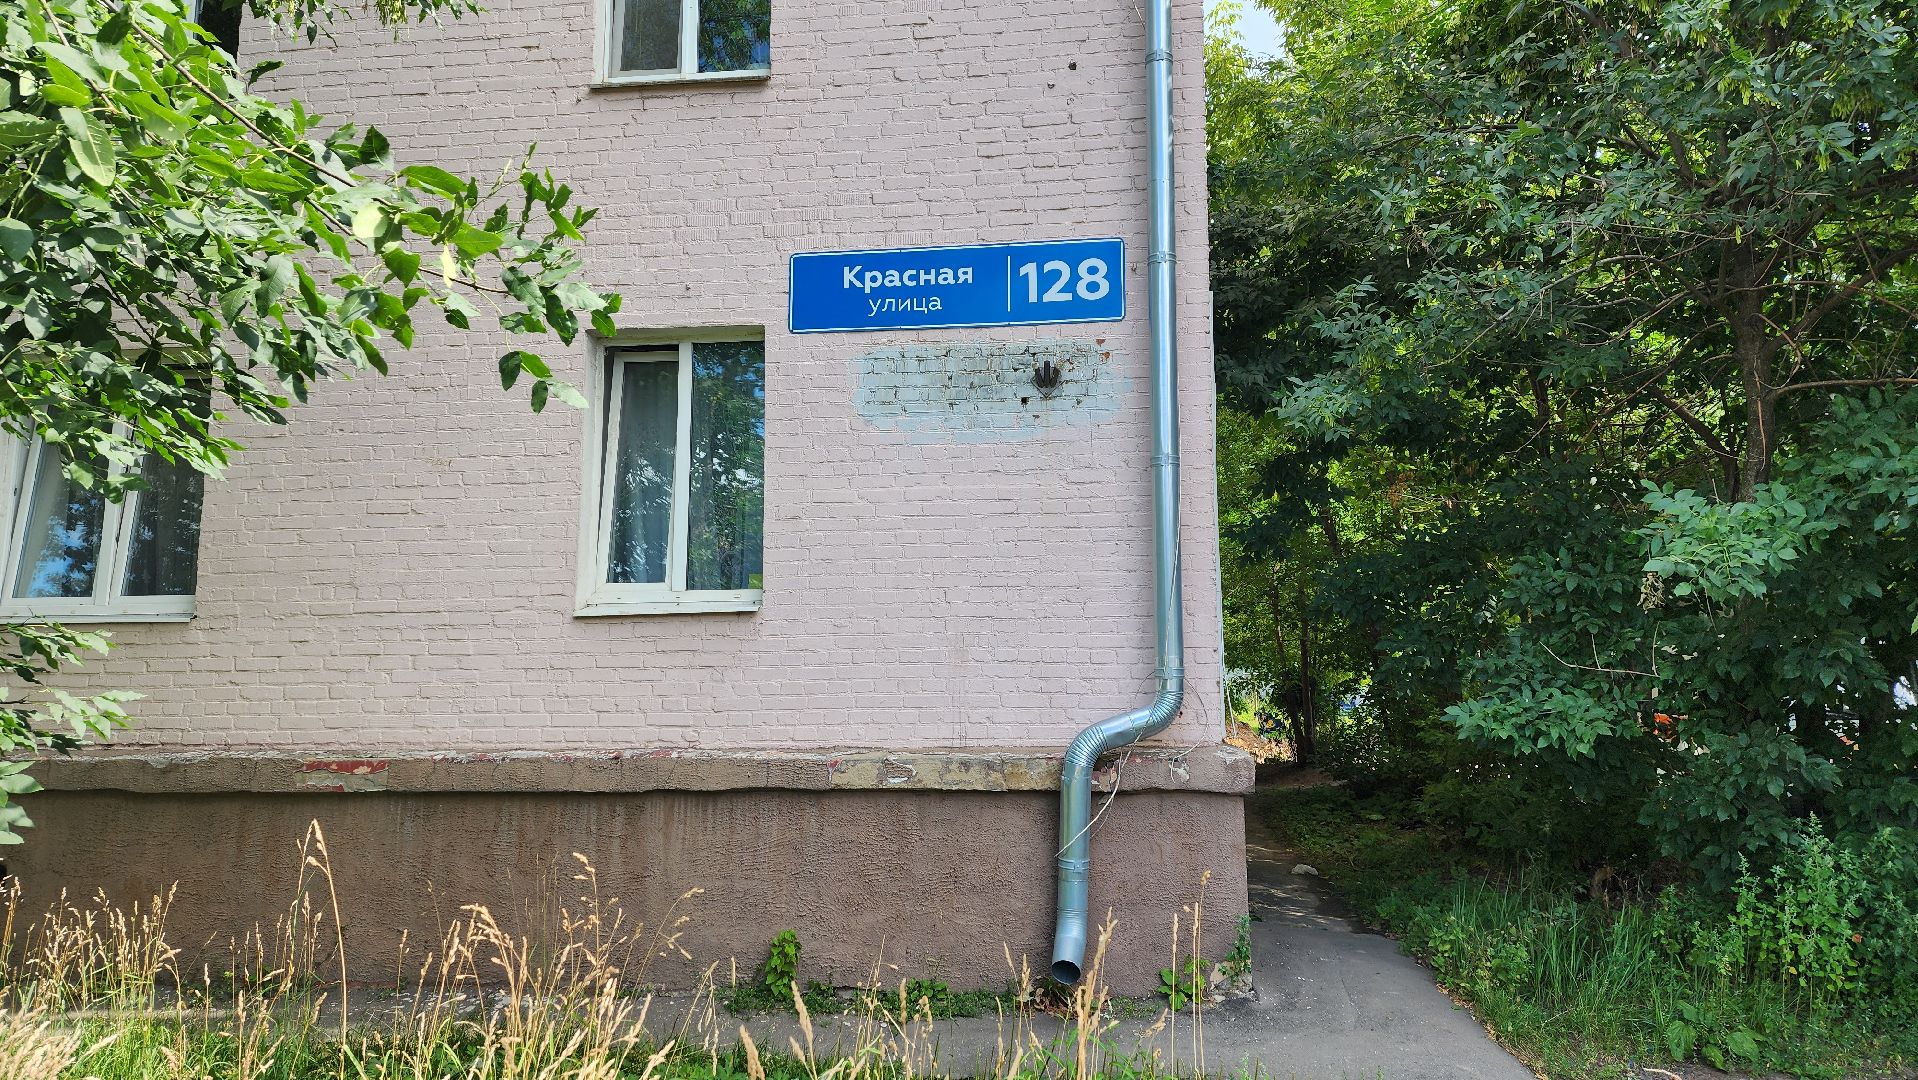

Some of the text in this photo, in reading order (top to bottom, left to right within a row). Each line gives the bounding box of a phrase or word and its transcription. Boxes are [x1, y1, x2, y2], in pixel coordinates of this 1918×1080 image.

[843, 265, 974, 294] Красная
[1019, 257, 1111, 303] 128
[867, 296, 943, 317] улица
